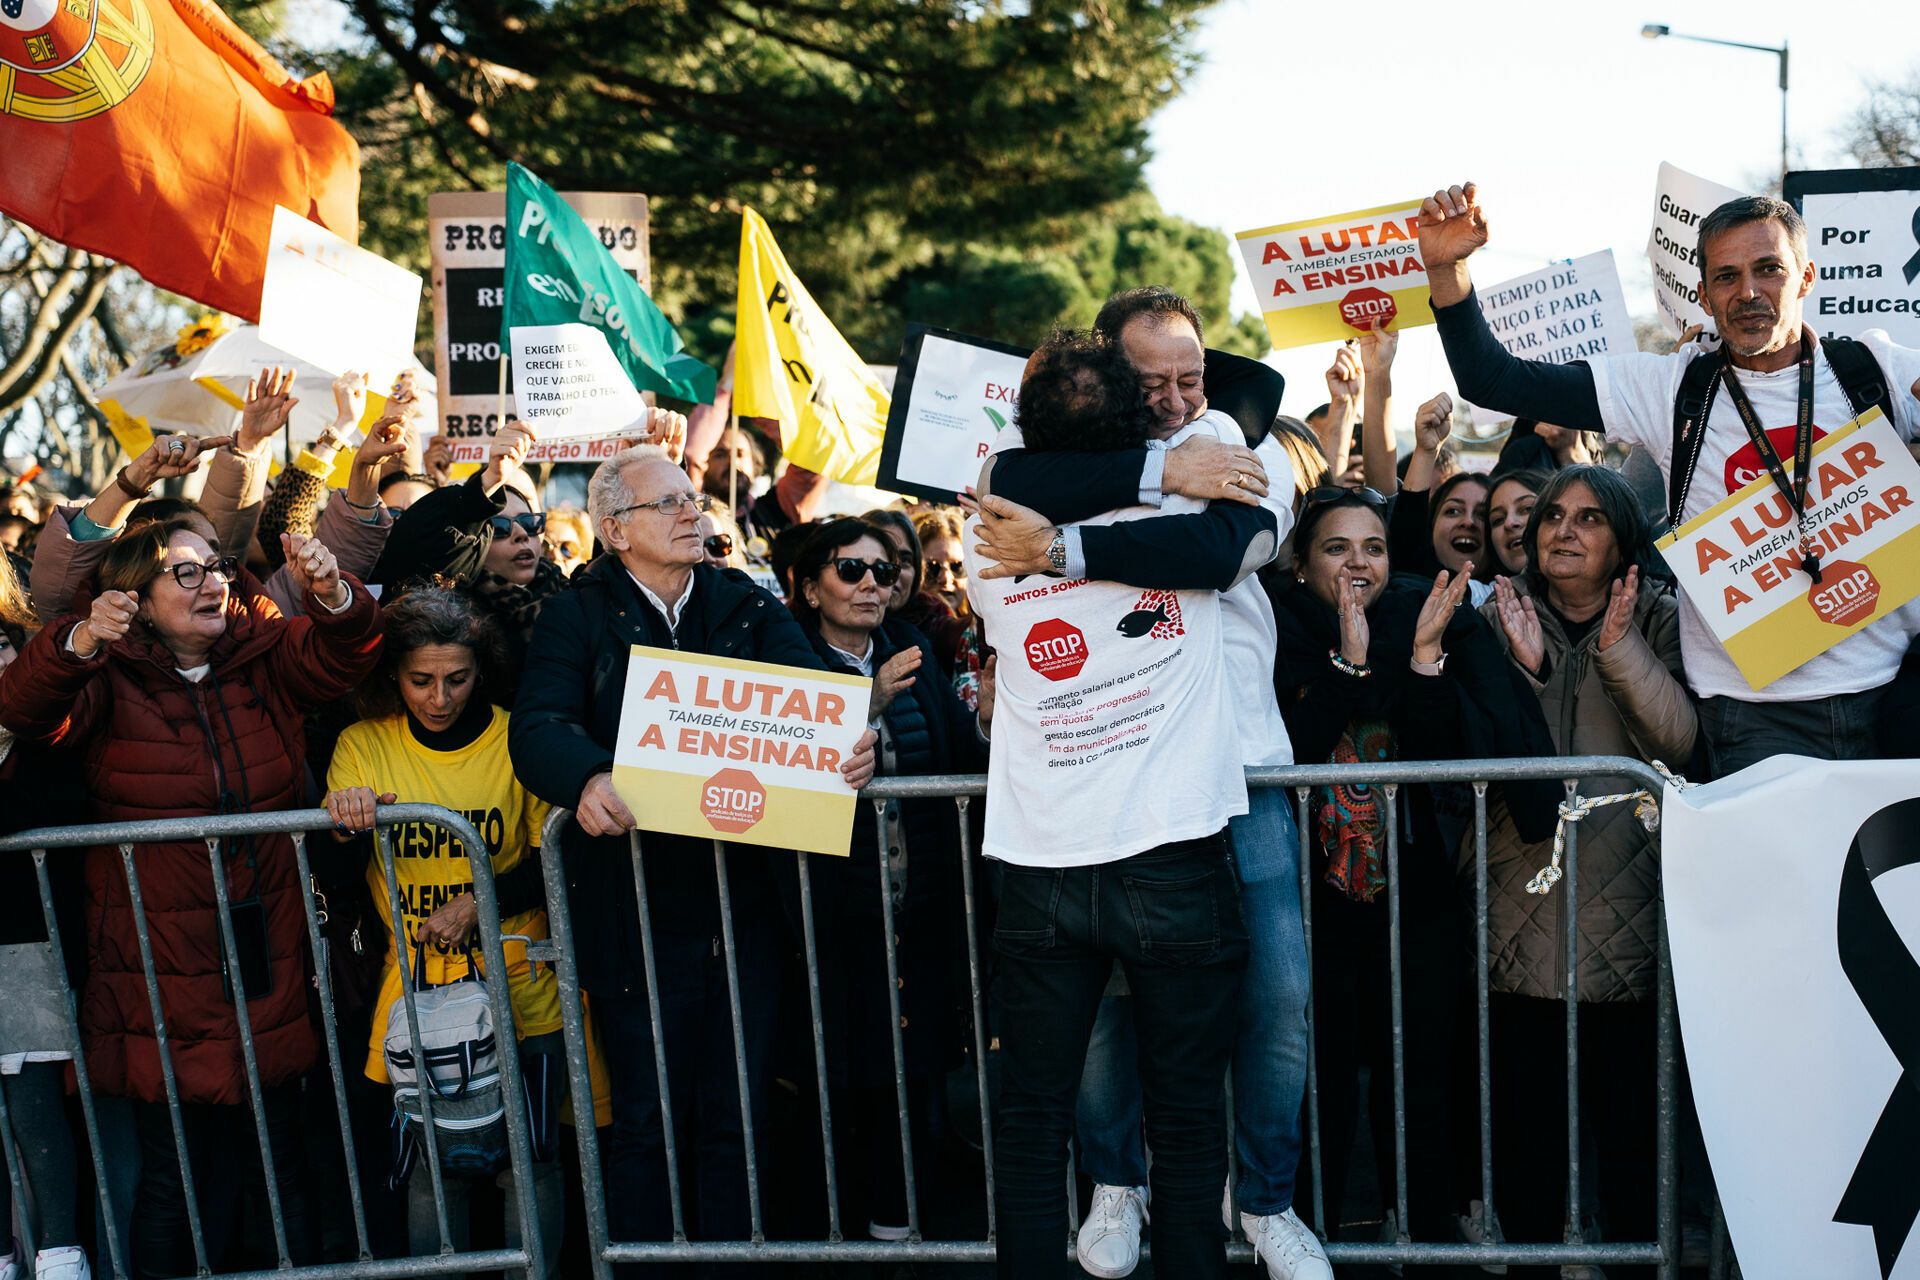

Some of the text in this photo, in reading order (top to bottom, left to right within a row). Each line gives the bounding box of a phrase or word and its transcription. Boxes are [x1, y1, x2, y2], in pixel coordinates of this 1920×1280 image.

[1821, 227, 1871, 245] Por
[1262, 241, 1292, 265] A
[1286, 244, 1415, 274] TAMBÉM ESTAMOS
[1273, 256, 1426, 297] A ENSINA
[1820, 264, 1883, 280] uma
[1487, 279, 1546, 310] TEMPO
[1552, 269, 1578, 290] DE
[1489, 288, 1602, 333] VIÇO É PARA
[1819, 296, 1920, 319] Educaç
[1504, 310, 1604, 353] TAR, NÃO É
[525, 345, 565, 355] EXIGEM
[525, 360, 565, 370] CRECHE
[526, 376, 548, 386] QUE
[527, 390, 580, 401] TRABALHO
[582, 390, 588, 398] E
[590, 389, 597, 397] O
[984, 383, 1016, 404] EXI
[1756, 435, 1769, 456] TODOS
[1798, 441, 1806, 463] TODOS
[1695, 537, 1733, 576] A
[1729, 532, 1795, 575] TAMBÉM
[1003, 578, 1091, 606] JUNTOS SOMO
[1723, 584, 1753, 615] A
[644, 670, 846, 726] A LUTAR
[1038, 690, 1080, 704] umento
[1082, 679, 1115, 696] salarial
[1117, 672, 1136, 684] que
[668, 709, 815, 740] TAMBÉM ESTAMOS
[1040, 714, 1094, 727] sem quotas
[1044, 729, 1074, 741] gestão
[1076, 723, 1108, 738] escolar
[1109, 703, 1165, 729] democrática
[637, 723, 841, 773] A ENSINAR
[1048, 743, 1061, 753] fim
[1062, 744, 1074, 753] da
[1048, 758, 1077, 768] direito
[1078, 755, 1084, 765] à
[1125, 736, 1150, 749] todos
